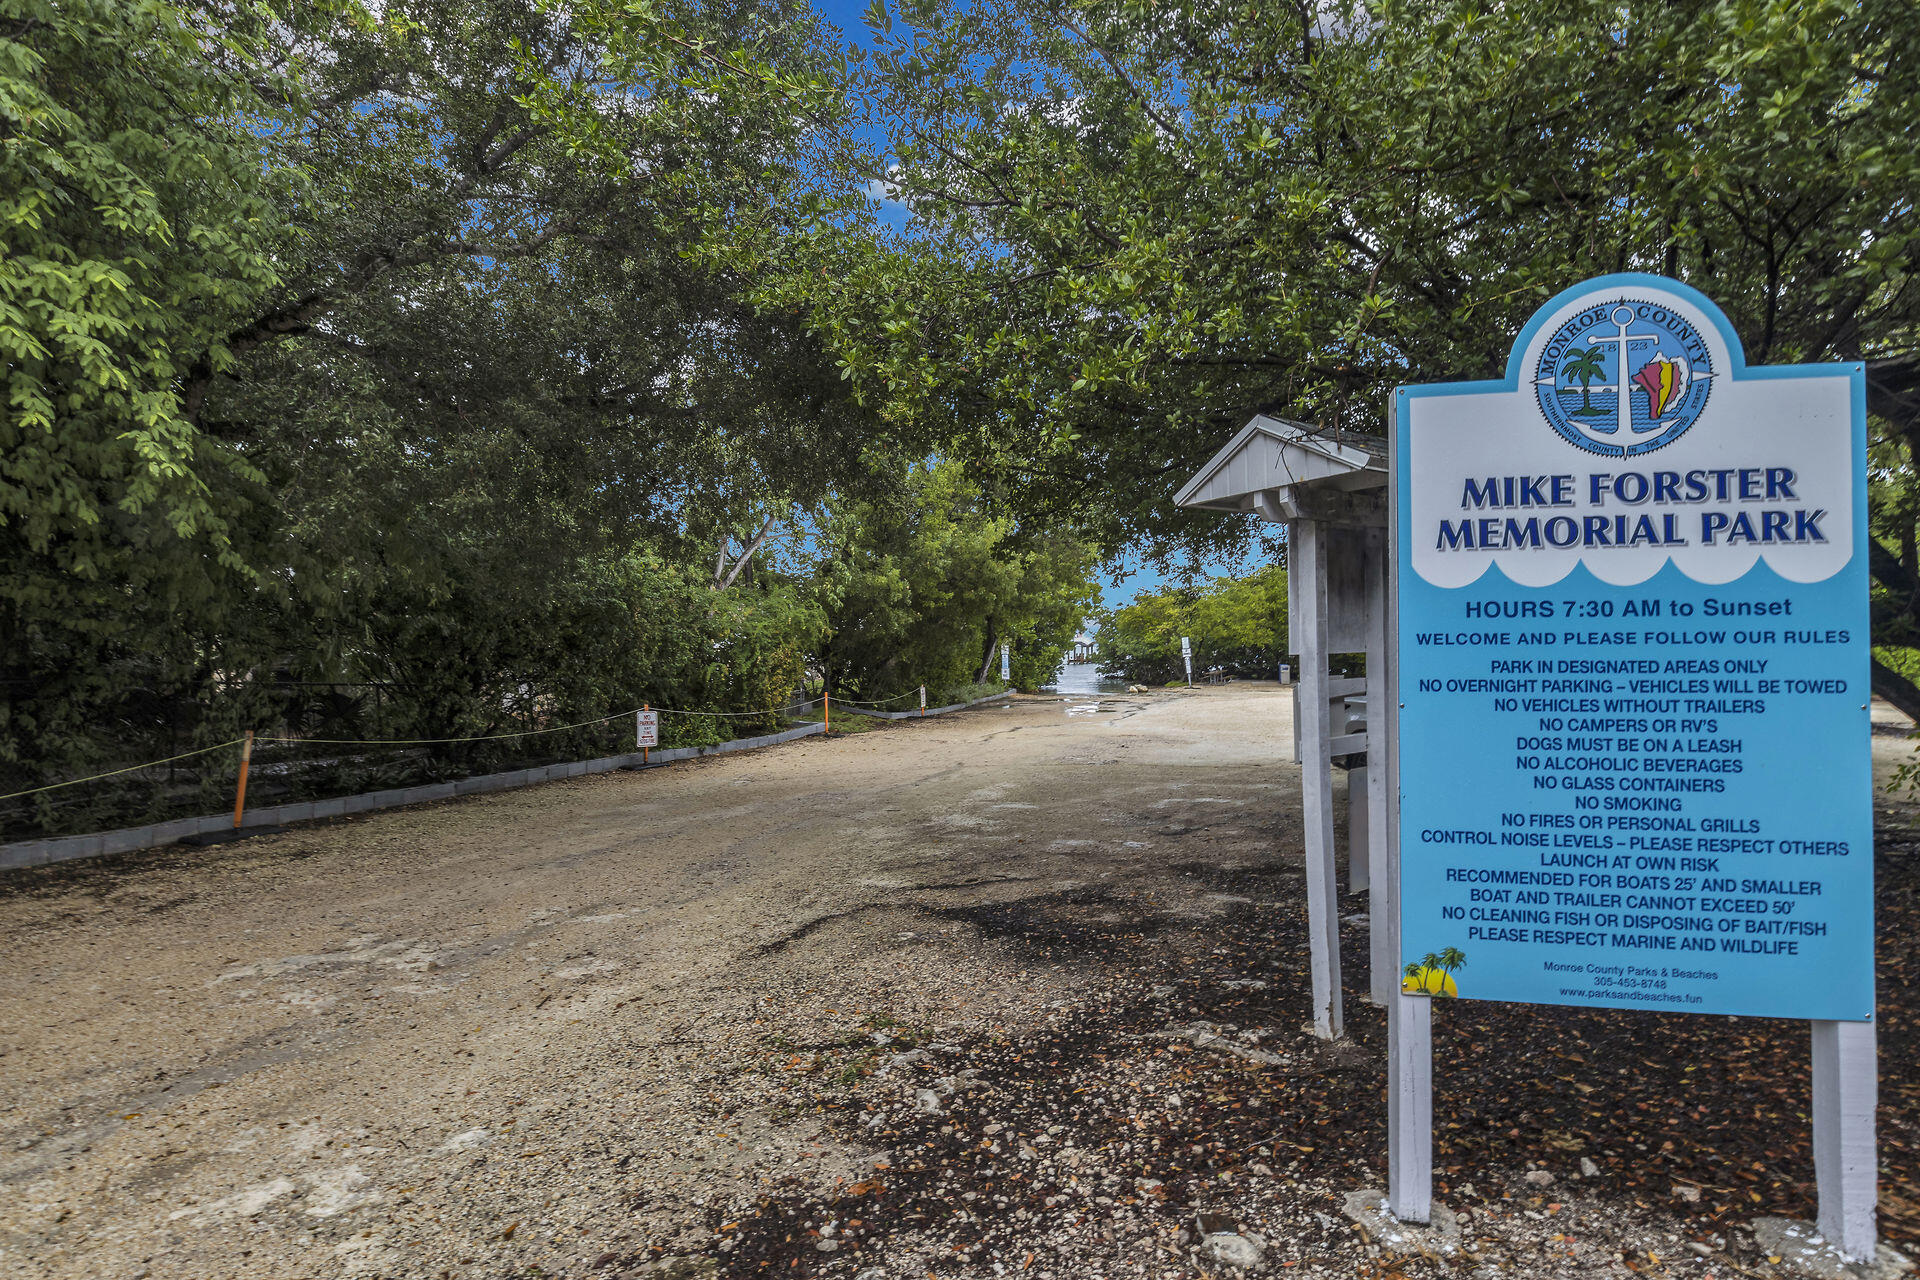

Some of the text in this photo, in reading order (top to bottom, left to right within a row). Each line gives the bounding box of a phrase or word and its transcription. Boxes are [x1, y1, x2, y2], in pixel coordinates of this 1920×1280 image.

[1541, 305, 1707, 375] MONROE COUNTY
[1601, 342, 1648, 352] 18 23
[1544, 392, 1581, 442] SOUTHERNMOST
[1588, 442, 1620, 454] COUNTY
[1644, 439, 1661, 449] THE
[1461, 468, 1800, 509] MIKE FORSTER
[1436, 509, 1829, 550] MEMORIAL PARK
[1466, 598, 1792, 618] HOURS 7:30 AM to Sunset
[1416, 630, 1850, 645] WELCOME AND PLEASE FOLLOW OUR RULES
[1492, 660, 1768, 674] PARK IN DESIGNATED AREAS ONLY
[1420, 679, 1442, 692] NO
[1446, 679, 1538, 692] OVERNIGHT
[1542, 680, 1612, 693] PARKING
[1629, 680, 1709, 693] VEHICLES
[1713, 680, 1754, 693] WILL
[1758, 680, 1780, 694] BE
[1784, 680, 1847, 694] TOWED
[1495, 698, 1765, 714] NO VEHICLES WITHOUT TRAILERS
[1540, 718, 1563, 731] NO
[1568, 718, 1648, 732] CAMPERS
[1652, 719, 1676, 732] OR
[1517, 737, 1742, 753] DOGS MUST BE ON A LEASH
[1517, 756, 1743, 773] NO ALCOHOLIC BEVERAGES
[1534, 776, 1725, 793] NO GLASS CONTAINERS
[1576, 796, 1682, 812] NO SMOKING
[1502, 813, 1760, 833] NO FIRES OR PERSONAL GRILLS
[1421, 830, 1498, 845] CONTROL
[1502, 832, 1550, 846] NOISE
[1554, 834, 1613, 849] LEVELS
[1630, 836, 1692, 851] PLEASE
[1698, 838, 1775, 854] RESPECT
[1779, 840, 1849, 856] OTHERS
[1541, 853, 1720, 872] LAUNCH AT OWN RISK
[1446, 868, 1574, 886] RECOMMENDED
[1579, 874, 1612, 888] FOR
[1617, 876, 1670, 890] BOATS
[1701, 878, 1737, 892] AND
[1742, 880, 1821, 896] SMALLER
[1470, 888, 1512, 903] BOAT
[1516, 890, 1550, 904] AND
[1554, 892, 1621, 908] TRAILER
[1626, 895, 1696, 910] CANNOT
[1701, 898, 1768, 913] EXCEED
[1442, 906, 1826, 936] NO CLEANING FISH OR DISPOSING OF BAIT/FISH
[1469, 926, 1798, 955] PLEASE RESPECT MARINE AND WILDLIFE
[1544, 962, 1718, 980] Monroe County Parks & Beaches
[1594, 977, 1666, 989] 305-453-8748
[1560, 989, 1702, 1003] www.parksandbeaches.fun
